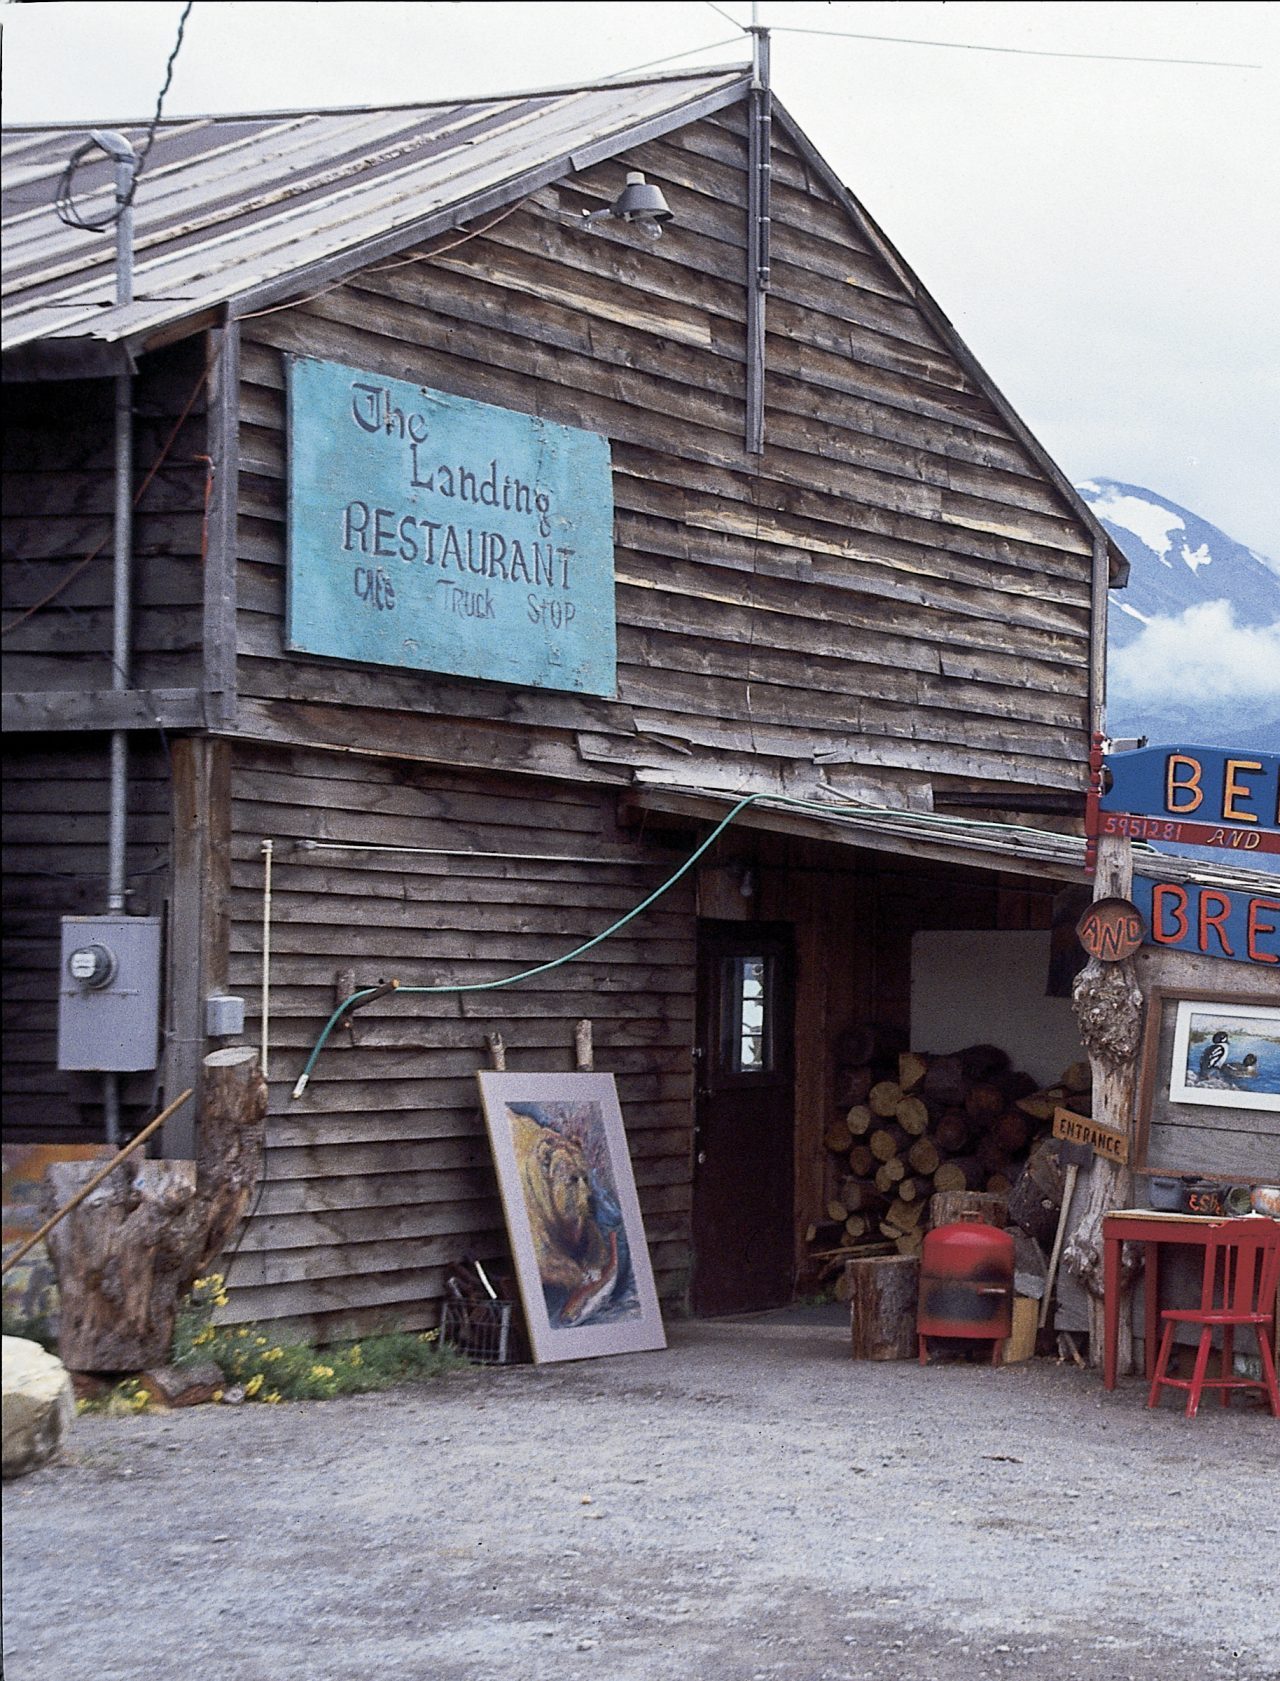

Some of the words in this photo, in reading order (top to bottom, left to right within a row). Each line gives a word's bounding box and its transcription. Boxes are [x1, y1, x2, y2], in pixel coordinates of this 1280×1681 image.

[352, 382, 429, 444] The
[409, 443, 553, 538] Landing
[344, 500, 577, 590] RESTAURANT
[1103, 816, 1183, 841] 5951281
[1206, 828, 1261, 850] AND
[1080, 912, 1143, 960] AND
[1059, 1118, 1122, 1156] ENTRANCE
